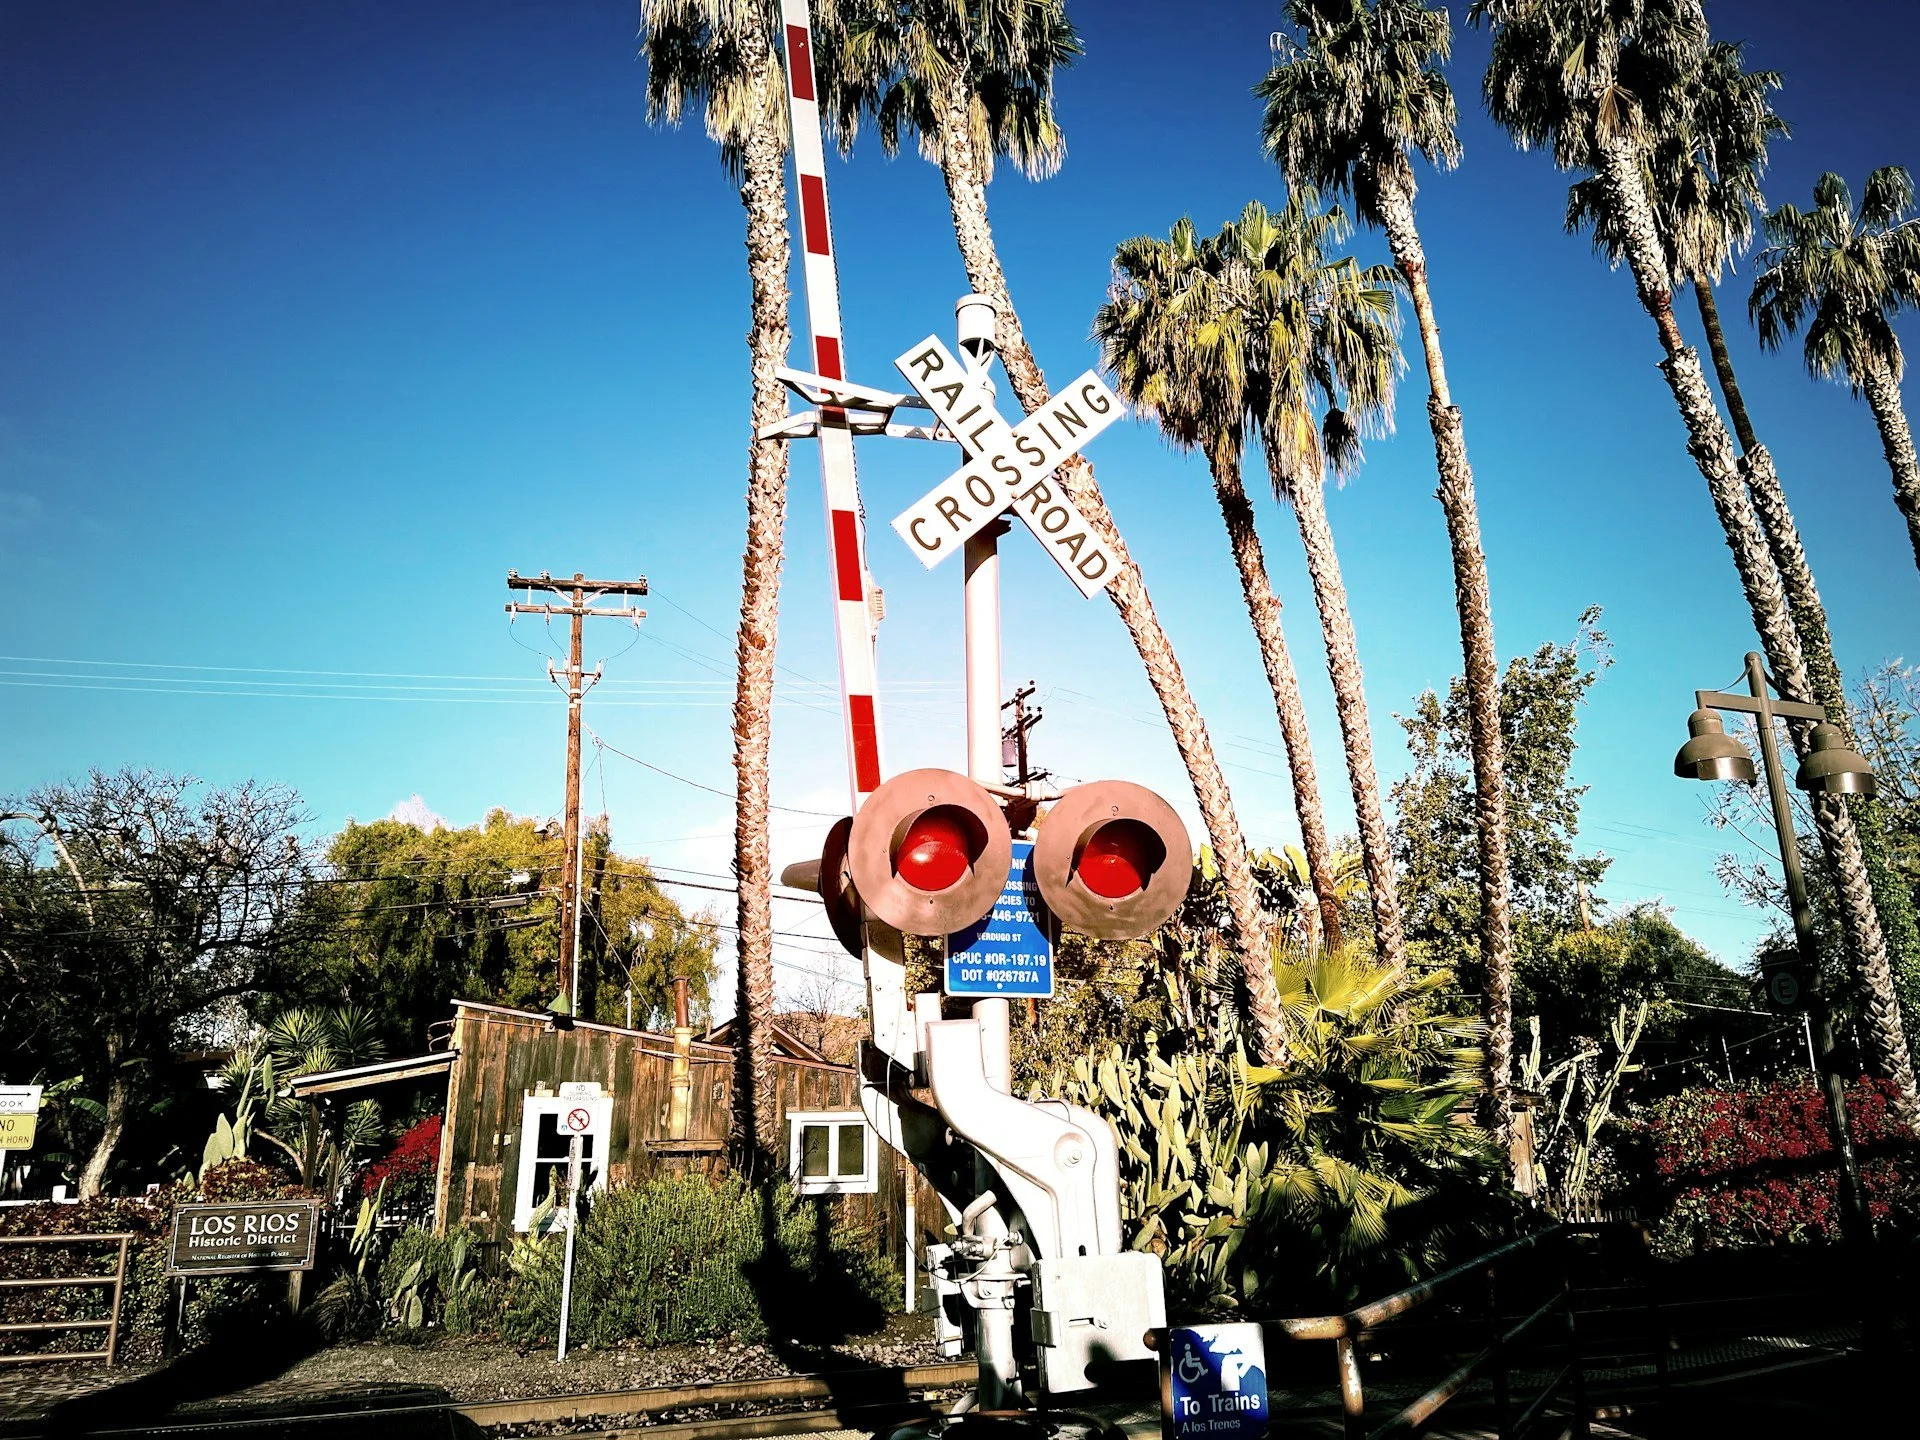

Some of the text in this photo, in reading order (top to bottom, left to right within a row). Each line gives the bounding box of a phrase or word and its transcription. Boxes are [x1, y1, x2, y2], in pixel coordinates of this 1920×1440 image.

[910, 348, 1108, 580] RAIL ROAD
[910, 384, 1110, 551] CROSSING
[1004, 881, 1038, 892] OSSING
[1025, 896, 1036, 907] TO
[981, 910, 1040, 923] -446-9721
[977, 932, 1021, 942] VERDUGO ST
[953, 952, 1047, 967] CPUC #OR-197.19
[961, 969, 1039, 983] DOT #026787A
[0, 1119, 14, 1131] NO
[7, 1136, 29, 1144] HORN
[191, 1213, 300, 1236] LOS RIOS
[189, 1233, 297, 1248] Historic District
[1180, 1392, 1261, 1416] To Trains
[1182, 1419, 1241, 1433] A los Trenes
